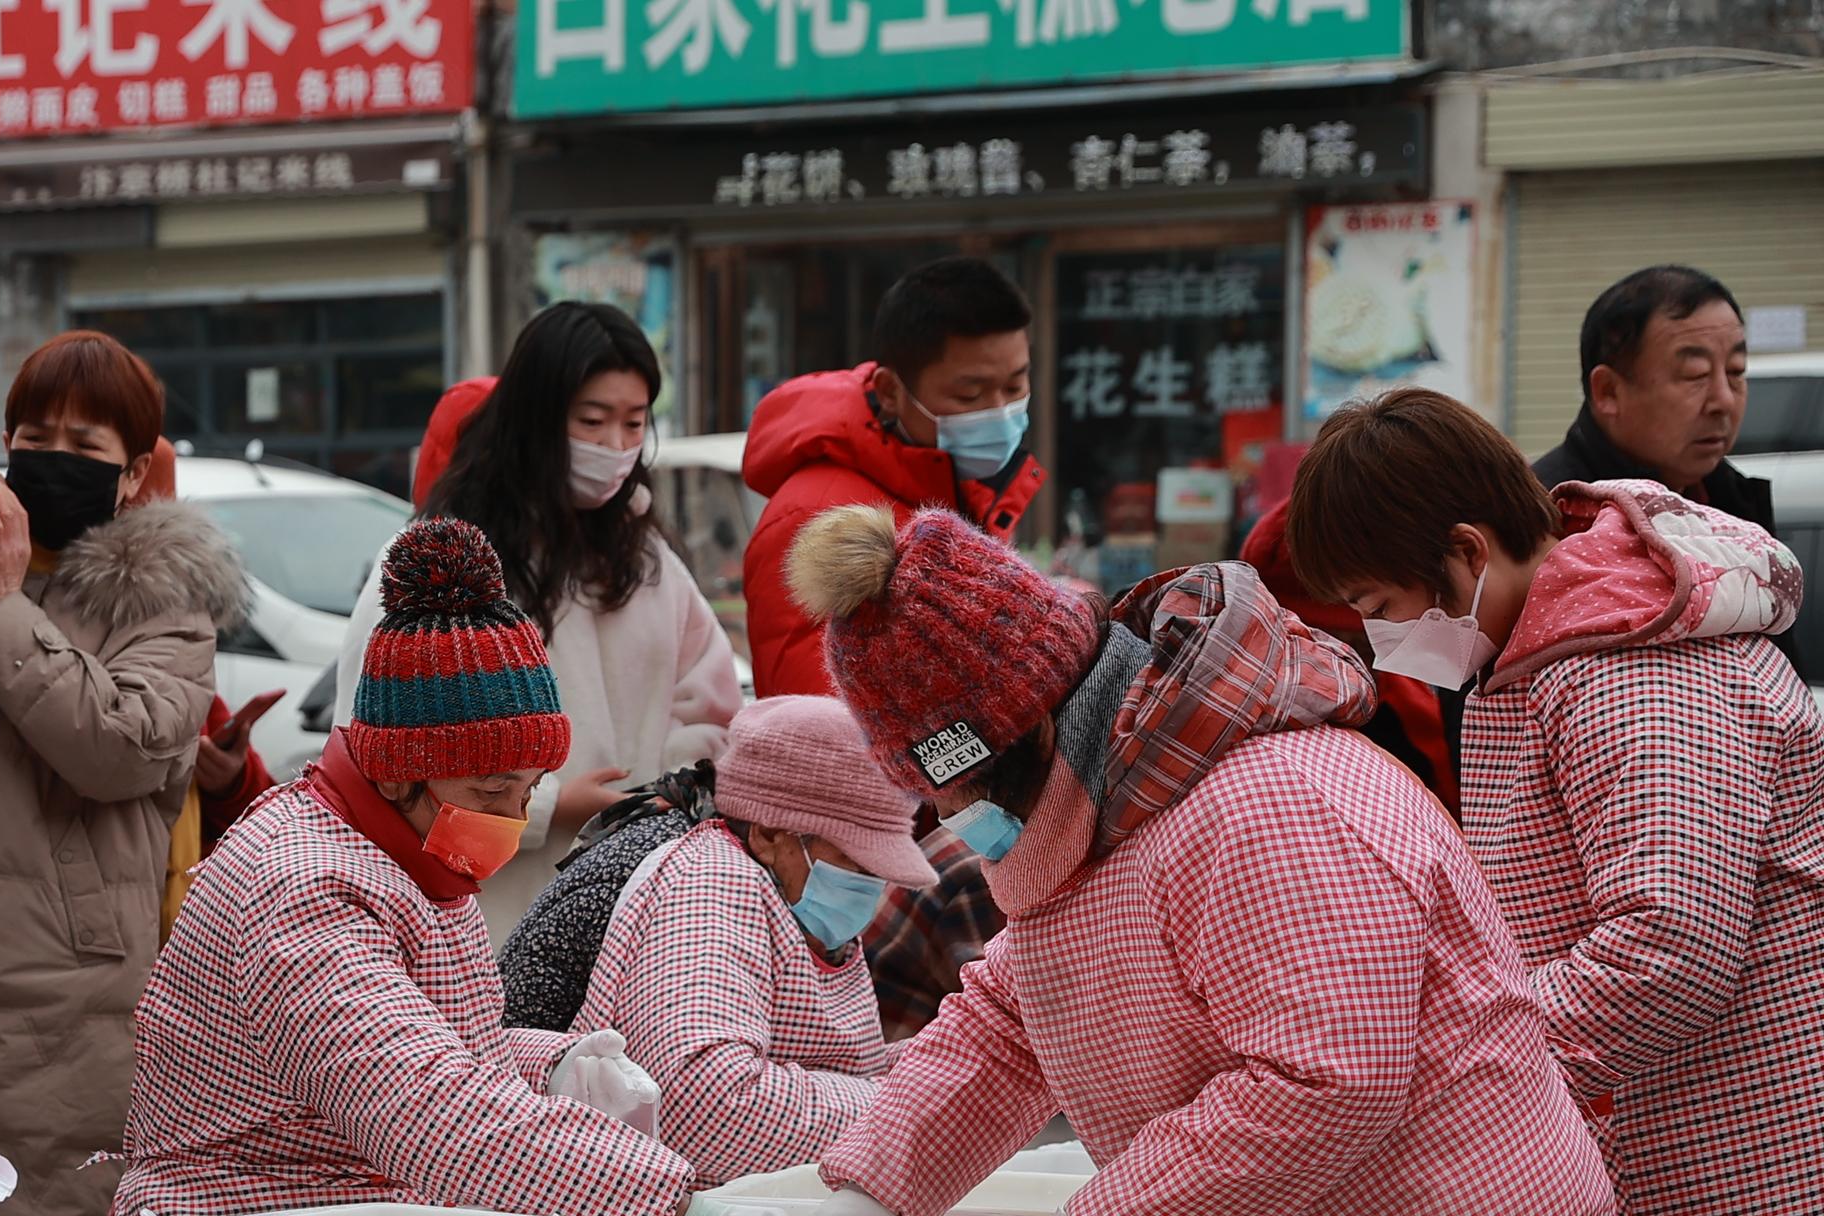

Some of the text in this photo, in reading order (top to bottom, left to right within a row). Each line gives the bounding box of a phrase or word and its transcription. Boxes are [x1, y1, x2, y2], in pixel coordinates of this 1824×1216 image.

[1063, 342, 1272, 420] 花生糕
[913, 721, 969, 758] WORLD
[920, 730, 976, 766] OCEANRACE
[932, 742, 985, 778] CREW
